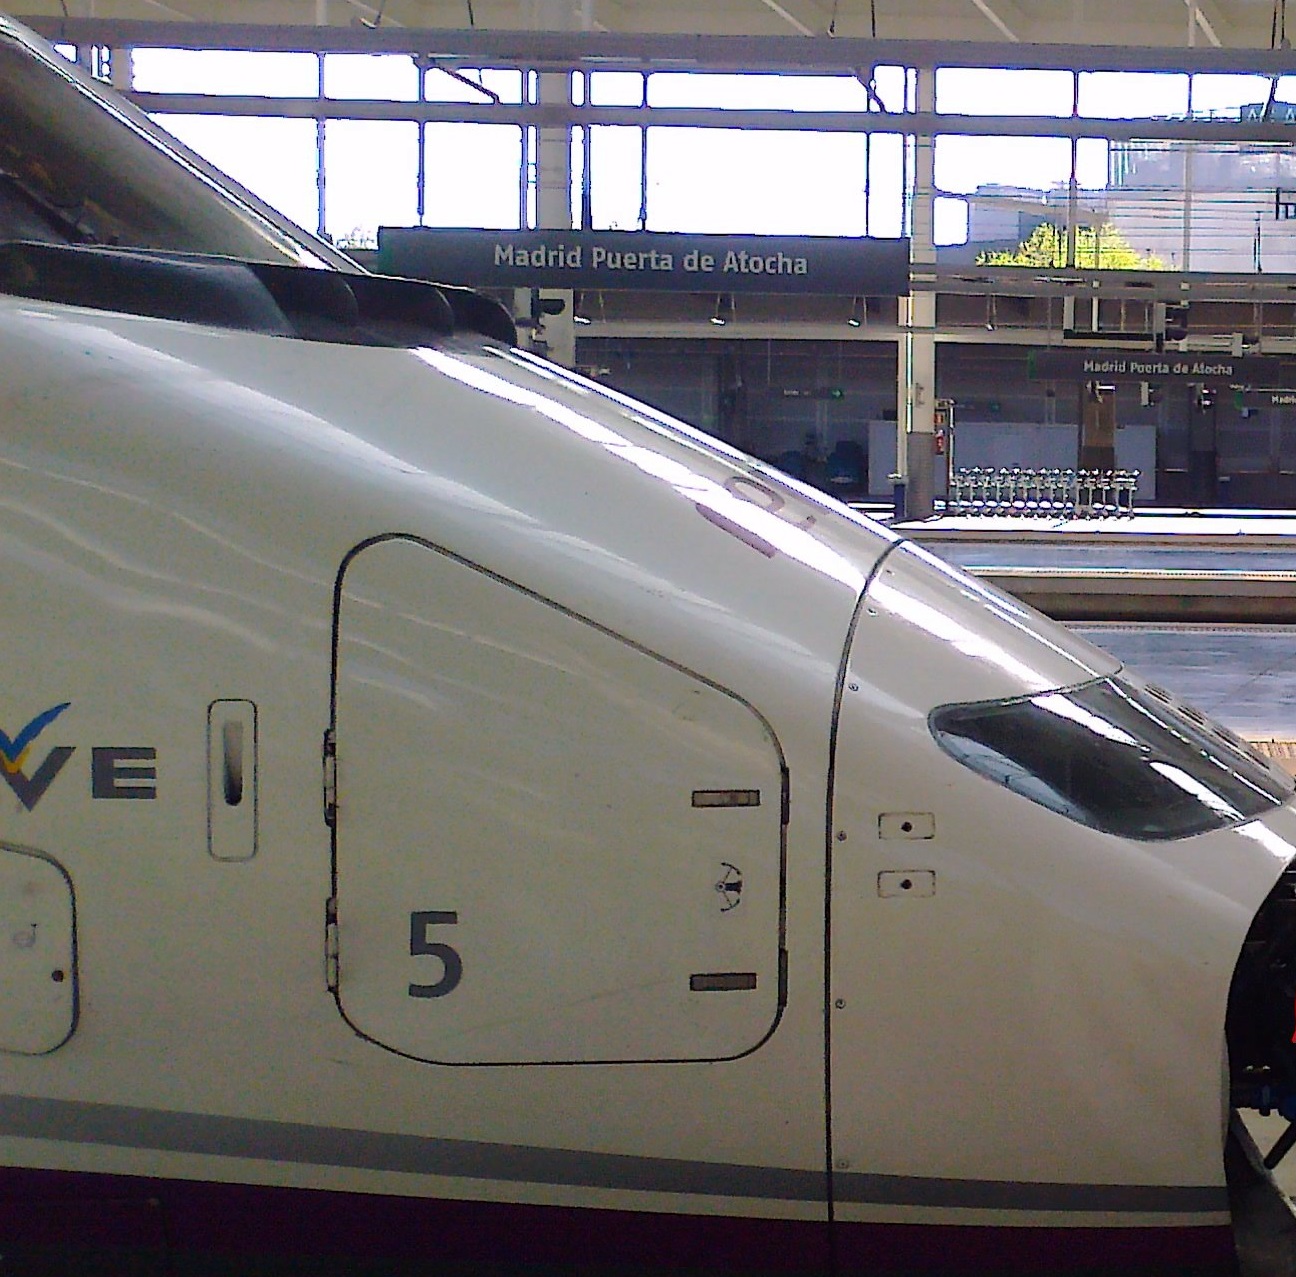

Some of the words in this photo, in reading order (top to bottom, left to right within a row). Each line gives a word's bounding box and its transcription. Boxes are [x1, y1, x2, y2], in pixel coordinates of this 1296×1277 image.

[494, 244, 582, 268] Madrid
[592, 247, 674, 271] Puerta
[683, 250, 716, 272] de
[723, 250, 808, 274] Atocha
[1083, 360, 1126, 373] Madrid
[1130, 361, 1169, 374] Puerta
[1173, 362, 1188, 374] de
[1192, 362, 1233, 375] Atocha
[408, 911, 464, 998] 5
